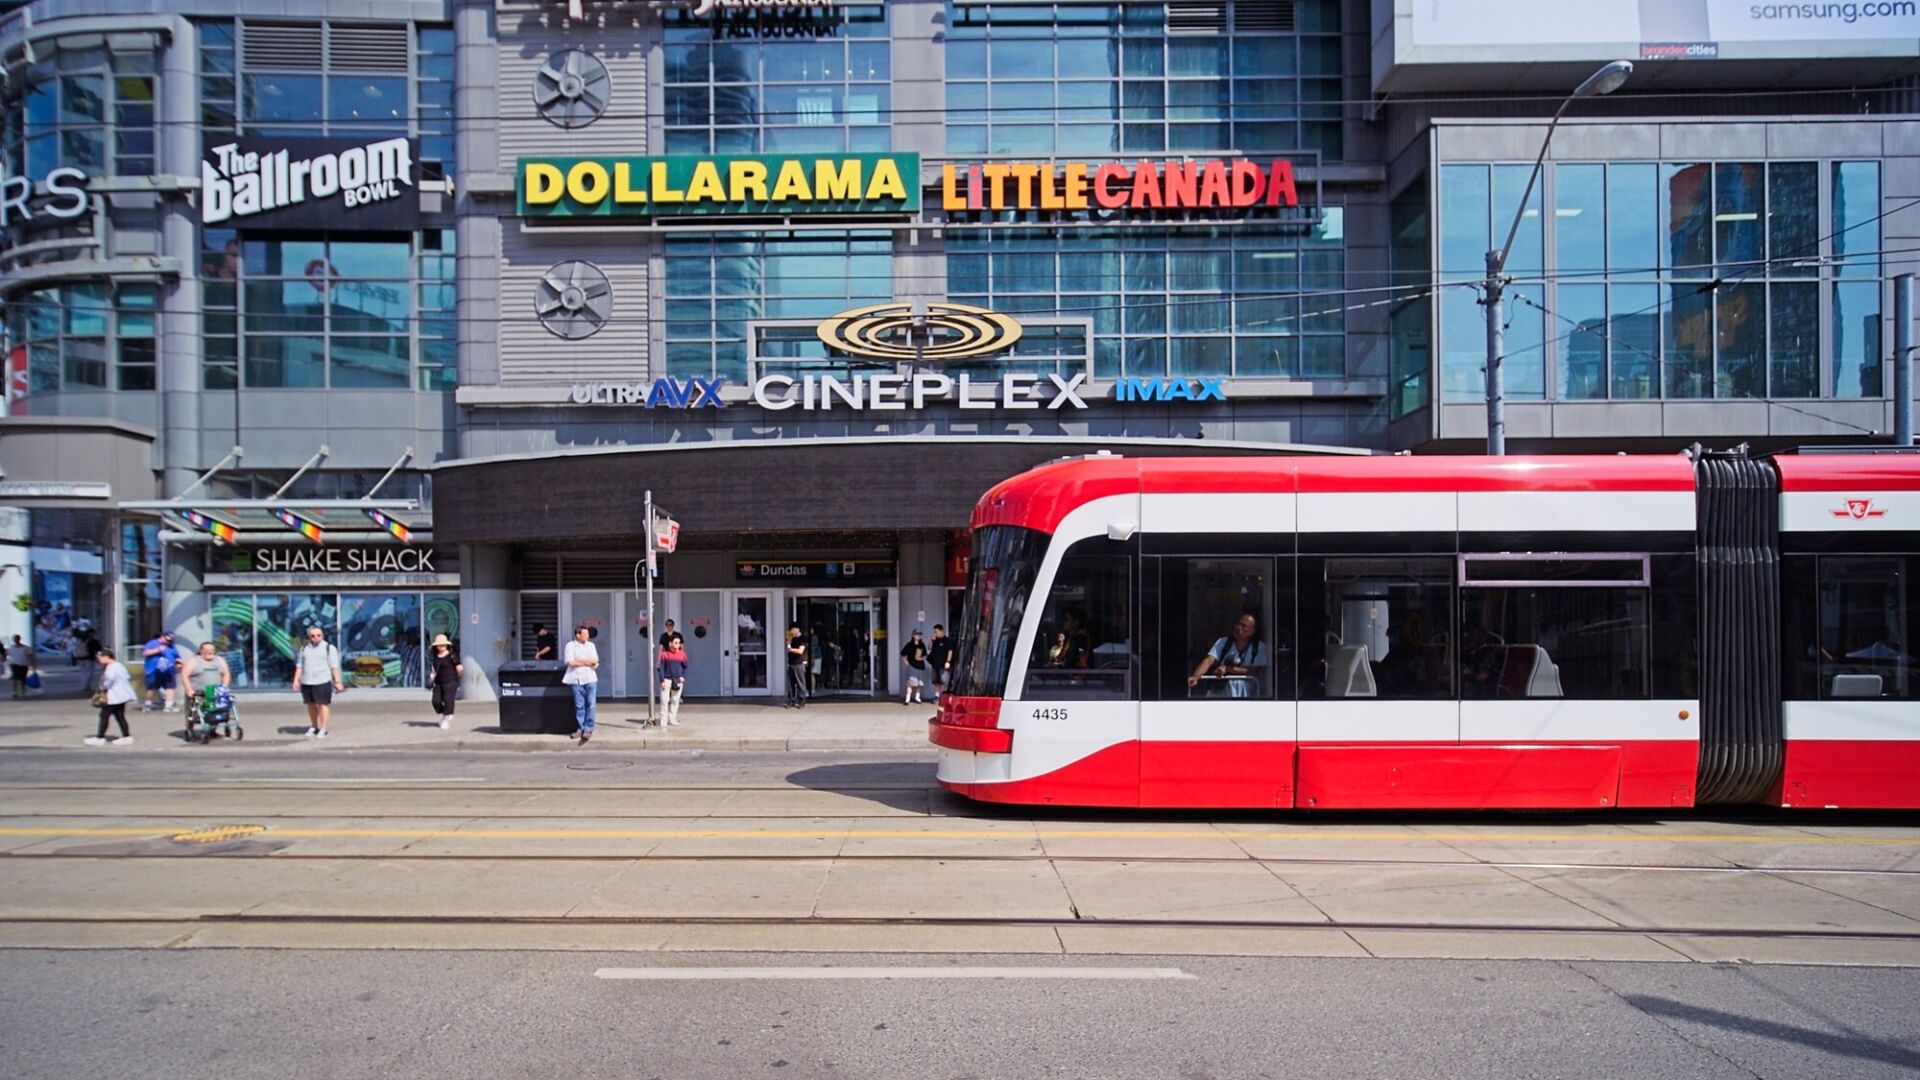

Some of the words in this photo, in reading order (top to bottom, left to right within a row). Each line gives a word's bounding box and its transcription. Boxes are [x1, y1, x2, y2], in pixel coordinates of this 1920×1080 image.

[1750, 1, 1916, 24] samsung.com
[211, 142, 260, 177] The
[202, 137, 413, 224] ballroom
[343, 179, 400, 208] BOWL
[525, 158, 908, 205] DOLLARAMA
[753, 372, 1089, 411] CINEPLEX
[1115, 376, 1228, 401] IMAX
[256, 548, 342, 571] SHAKE
[346, 548, 436, 571] SHACK
[760, 564, 808, 576] Dundas
[1032, 708, 1069, 721] 4435
